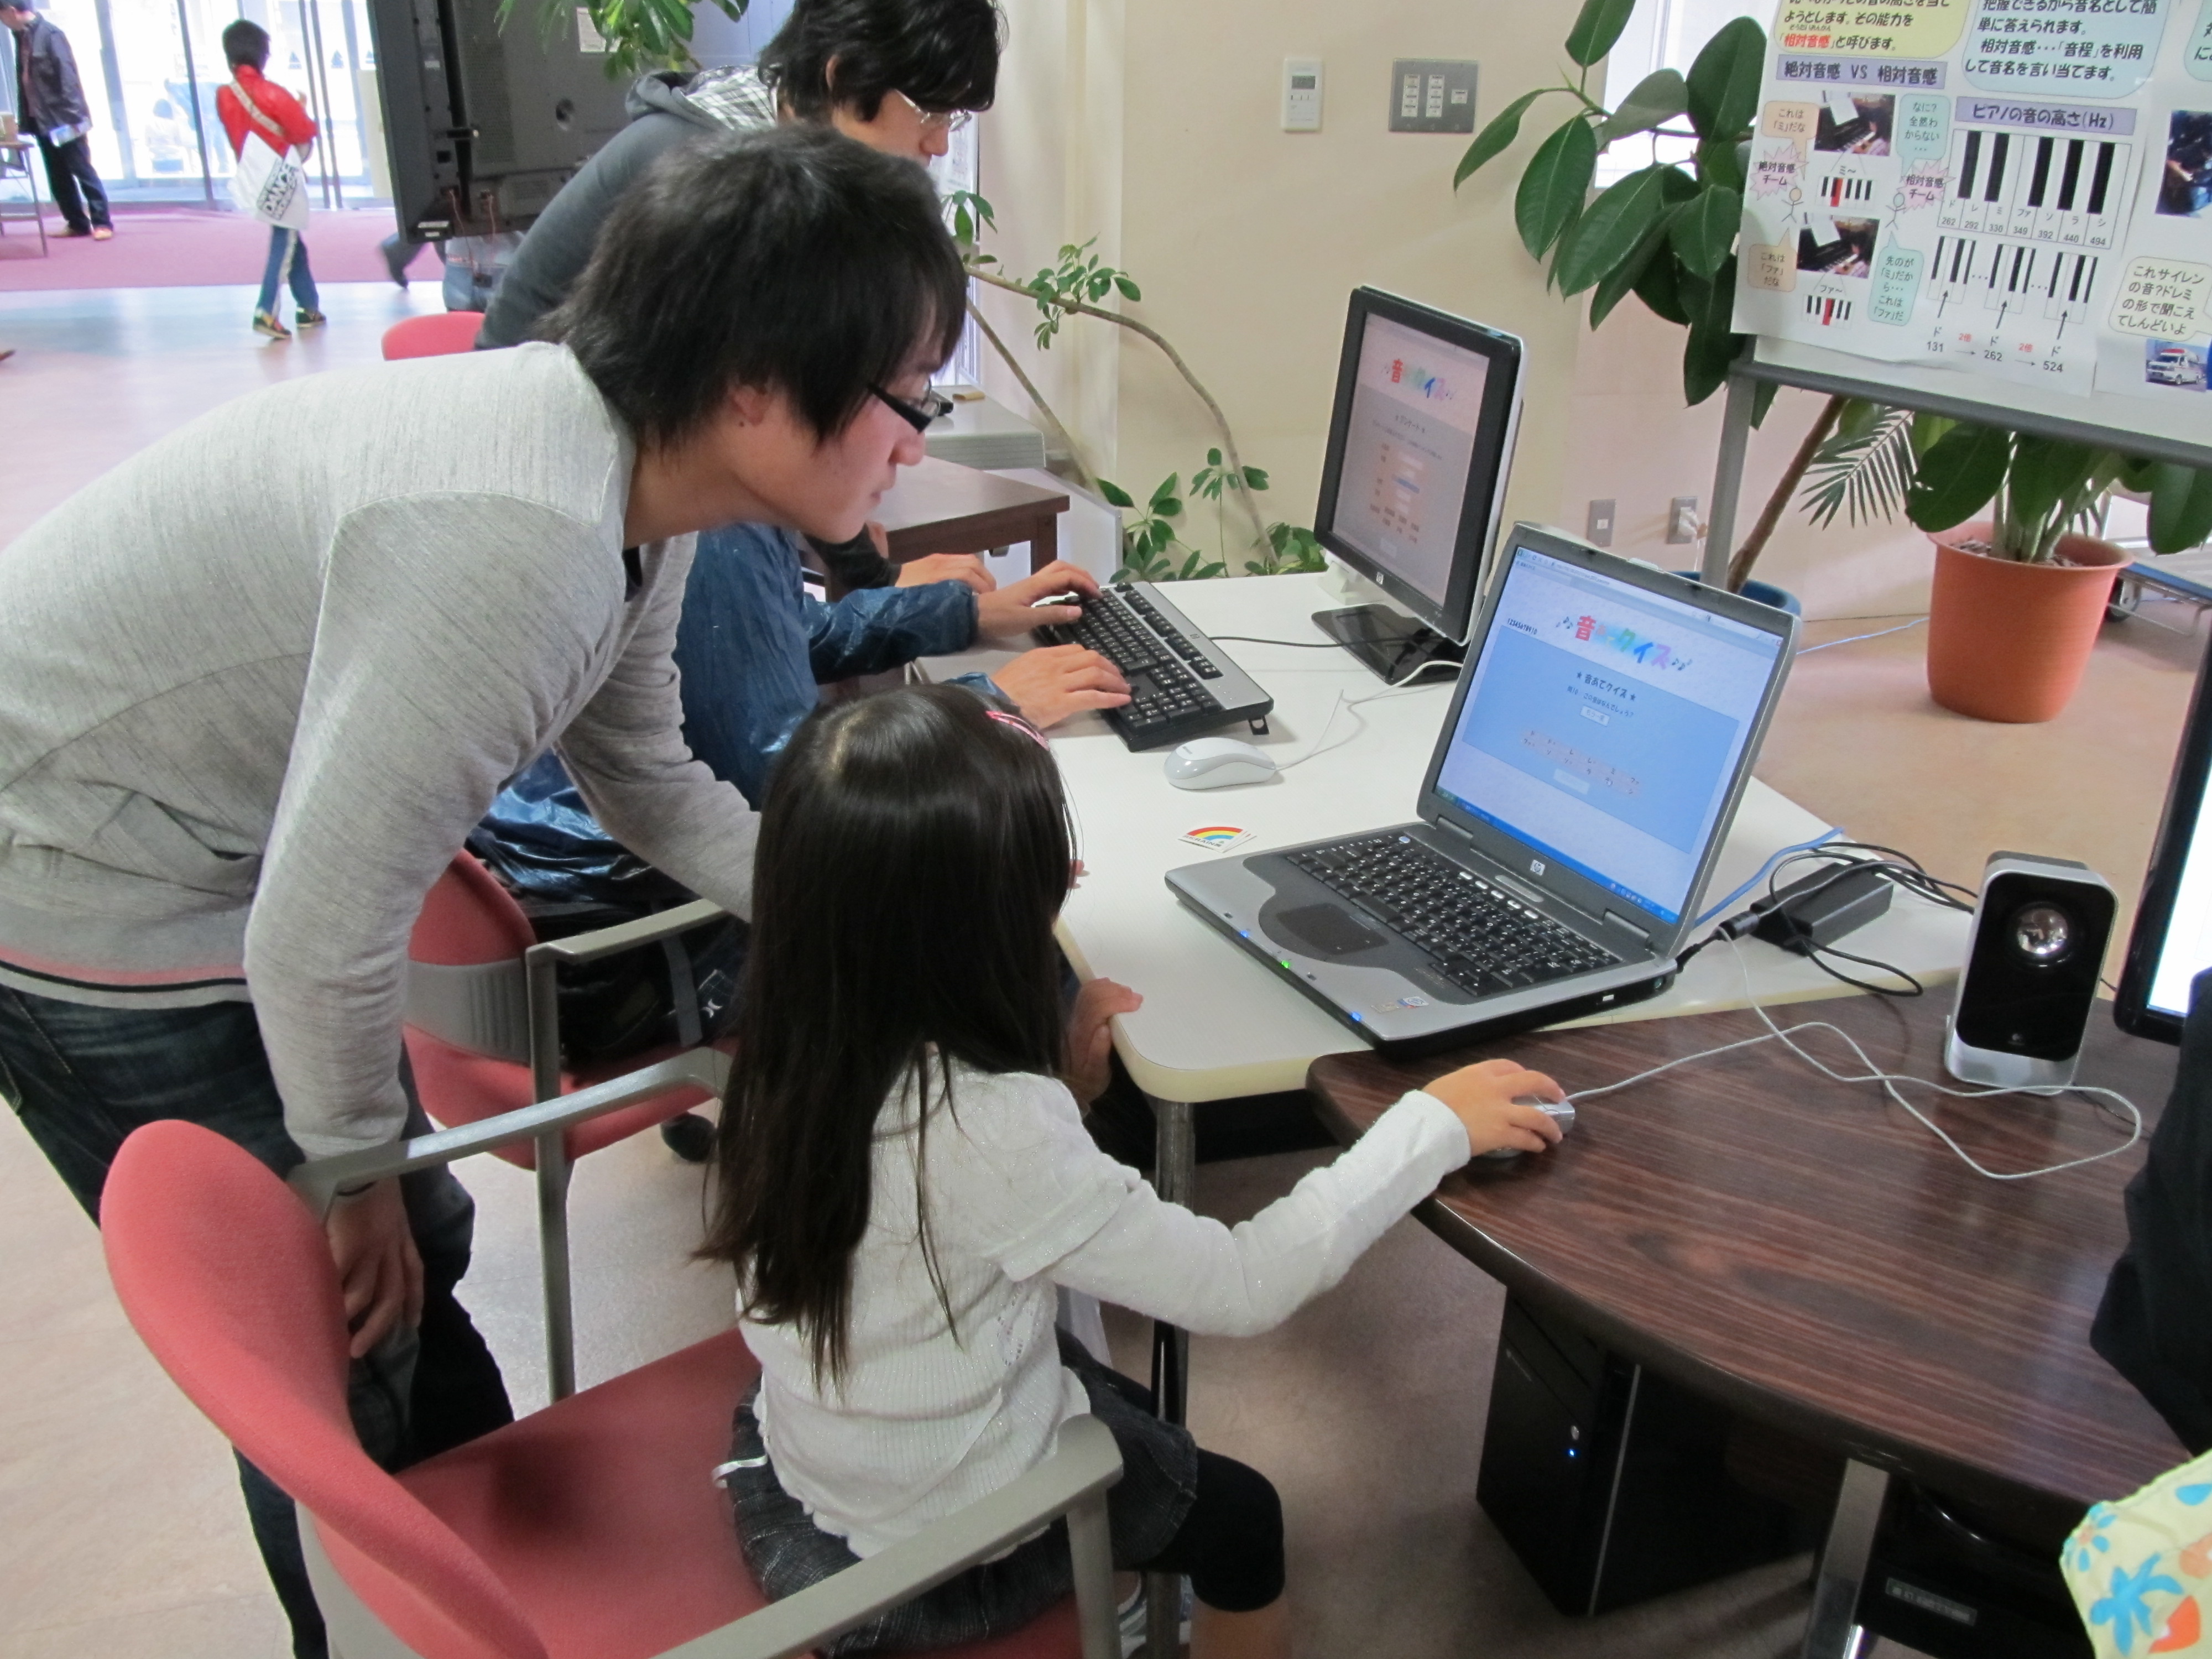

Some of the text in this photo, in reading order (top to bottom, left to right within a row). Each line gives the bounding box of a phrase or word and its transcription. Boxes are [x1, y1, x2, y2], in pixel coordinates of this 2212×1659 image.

[1978, 17, 2086, 35] 単に答えられます。
[1781, 33, 1896, 51] 「相対音感」と呼びます。
[1784, 61, 1939, 85] 絶対音感 VS 相対音感
[1964, 59, 2115, 81] して音名を言い当てます。
[1778, 109, 1804, 118] これは
[1910, 116, 1938, 127] 全然わ
[1905, 131, 1939, 141] からない
[1759, 160, 1796, 174] 絶対音感
[1762, 175, 1787, 186] チーム
[1907, 174, 1944, 189] 相対音感
[1909, 189, 1934, 200] チーム
[1942, 217, 2106, 246] 262 292 330 349 392 440 494
[1886, 255, 1914, 267] 先のが
[2133, 265, 2204, 284] これサイレン
[1878, 296, 1903, 307] これは
[2122, 299, 2195, 320] の形で聞こえ
[2117, 314, 2187, 335] てしんどいよ
[1933, 326, 1943, 337] ド
[1927, 341, 1944, 352] 131
[1990, 336, 2000, 346] ド
[1984, 350, 2002, 361] 262
[2051, 346, 2062, 357] ド
[2043, 361, 2064, 373] 524
